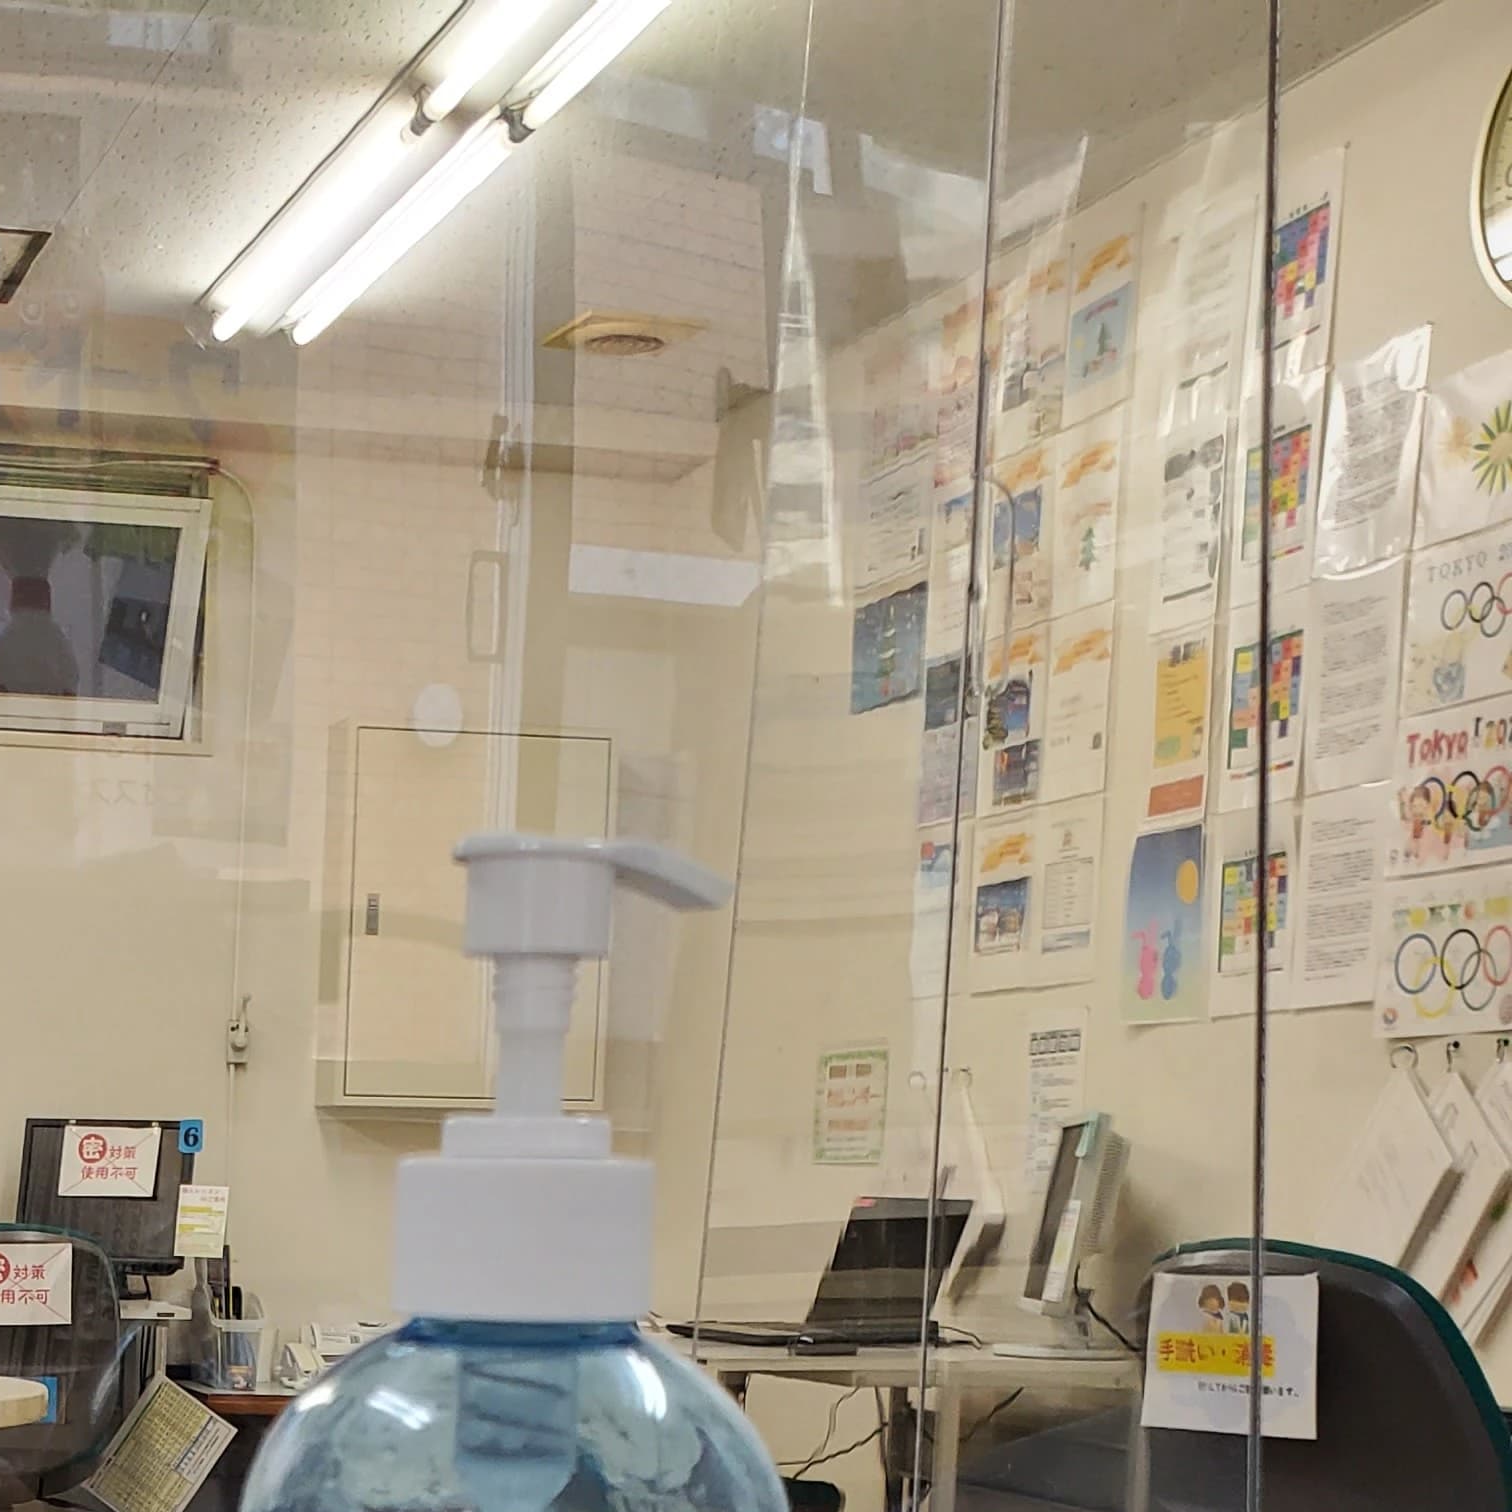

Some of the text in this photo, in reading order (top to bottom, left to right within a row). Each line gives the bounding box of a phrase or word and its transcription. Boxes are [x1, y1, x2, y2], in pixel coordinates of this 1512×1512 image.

[184, 1128, 198, 1147] 6
[80, 1136, 136, 1162] 密対策
[81, 1166, 138, 1180] 使用不可
